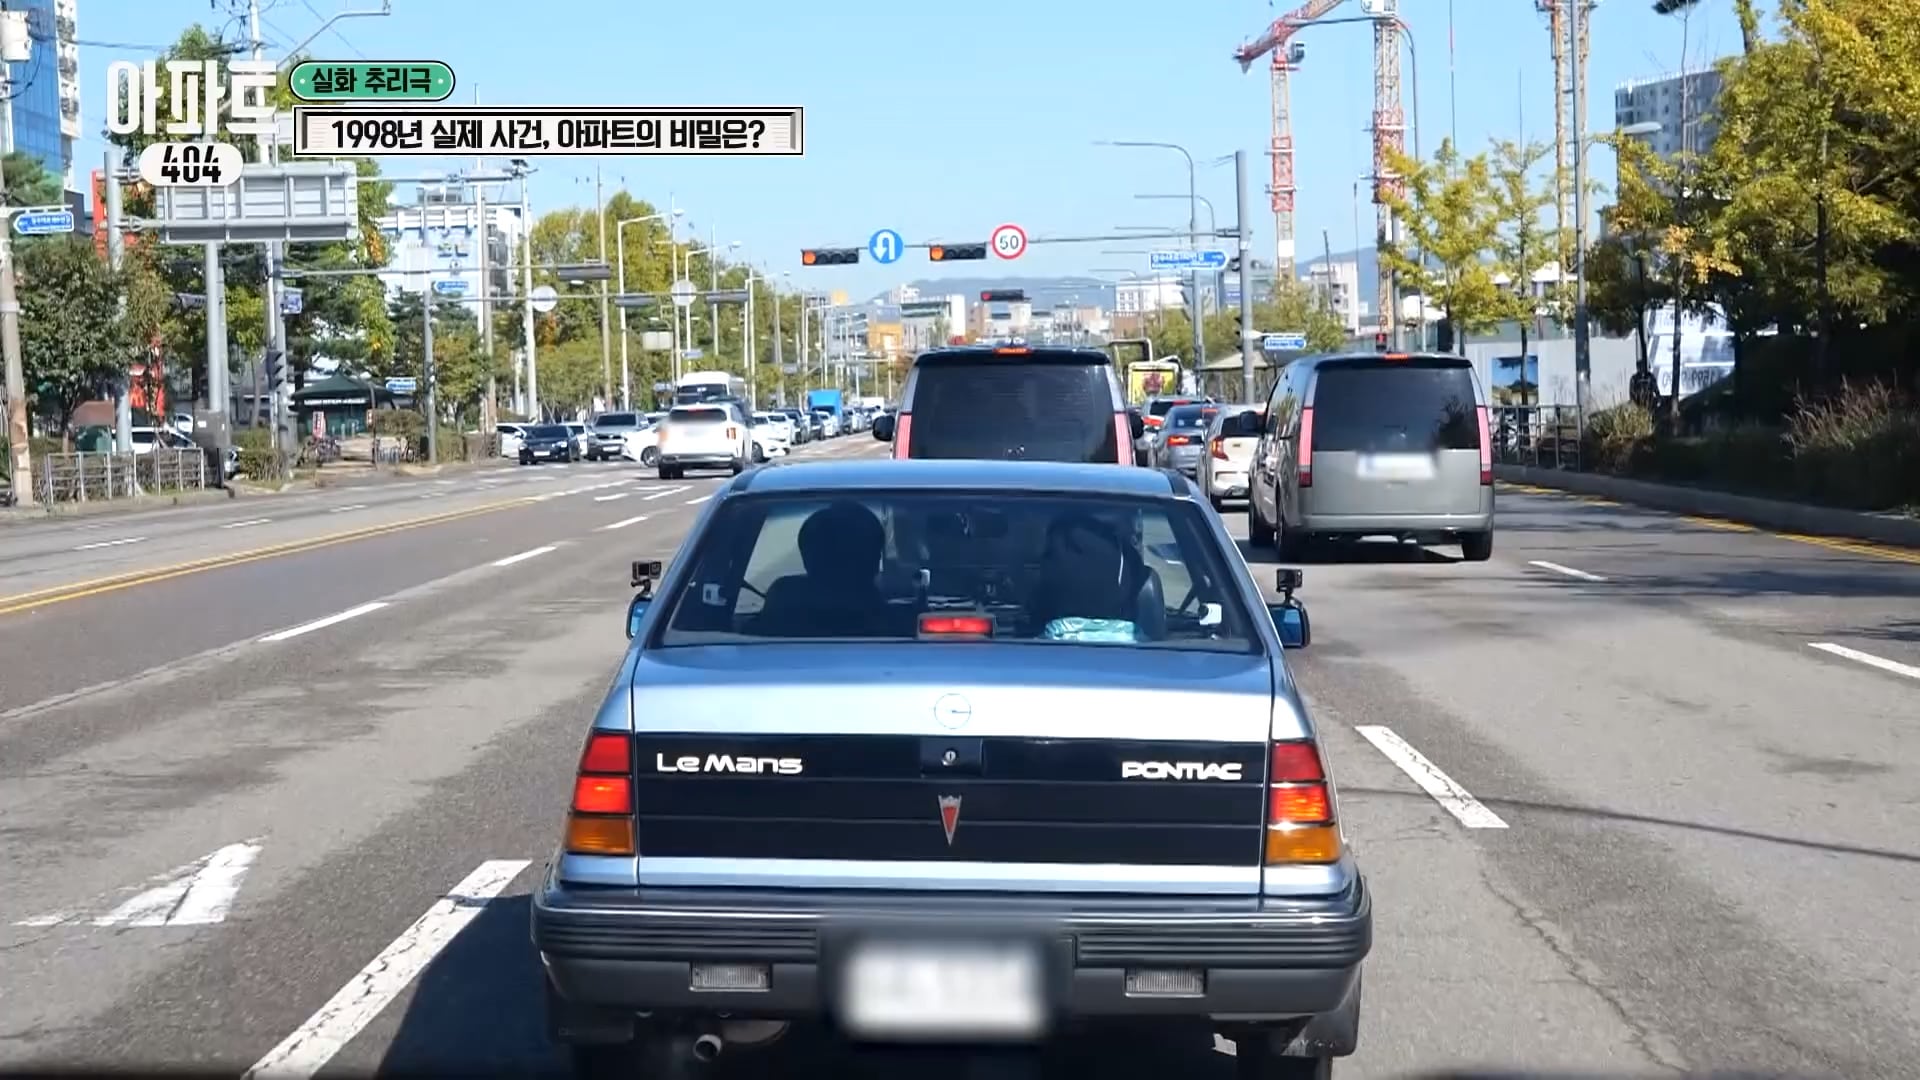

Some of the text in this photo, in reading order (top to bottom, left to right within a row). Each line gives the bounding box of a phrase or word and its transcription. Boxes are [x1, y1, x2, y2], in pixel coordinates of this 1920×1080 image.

[1000, 235, 1019, 250] 50
[656, 752, 803, 774] Le Mans
[1121, 761, 1243, 781] PONTIAC
